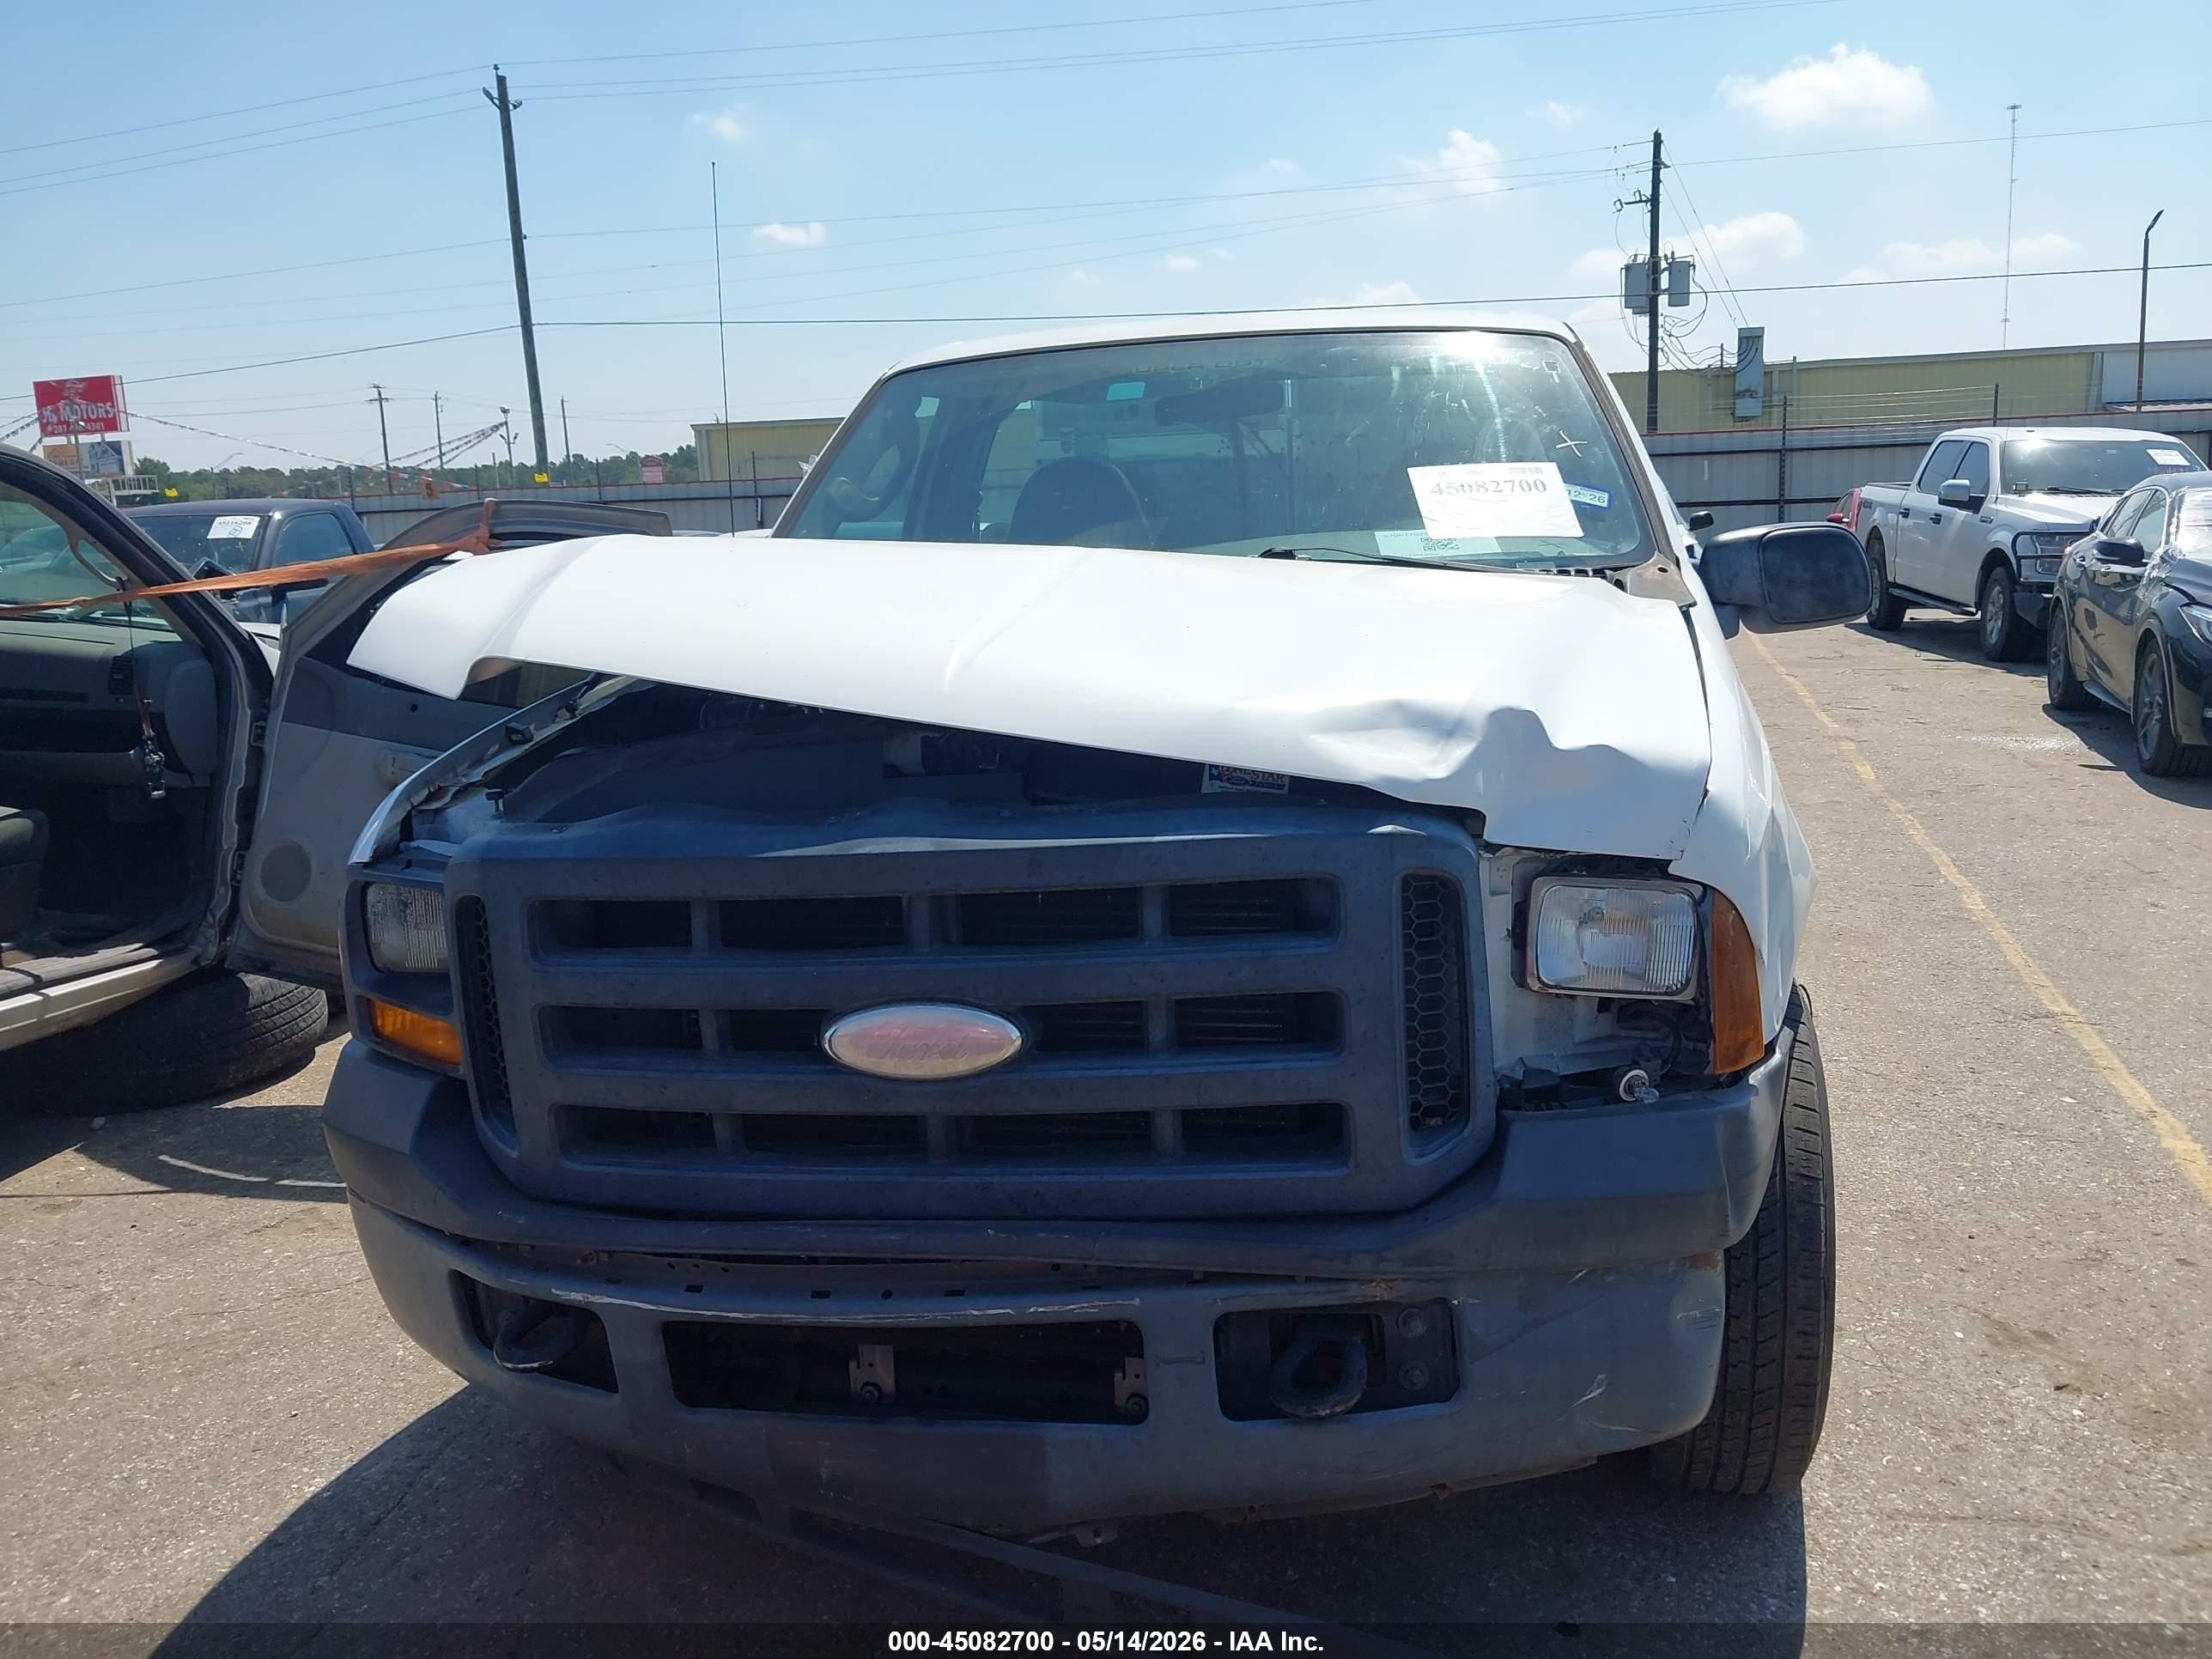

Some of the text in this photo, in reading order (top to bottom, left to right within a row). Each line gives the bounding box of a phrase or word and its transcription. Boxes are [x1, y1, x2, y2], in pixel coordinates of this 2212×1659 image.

[59, 401, 114, 422] MOTORS
[1431, 479, 1547, 495] 45082700
[1589, 494, 1606, 504] 26
